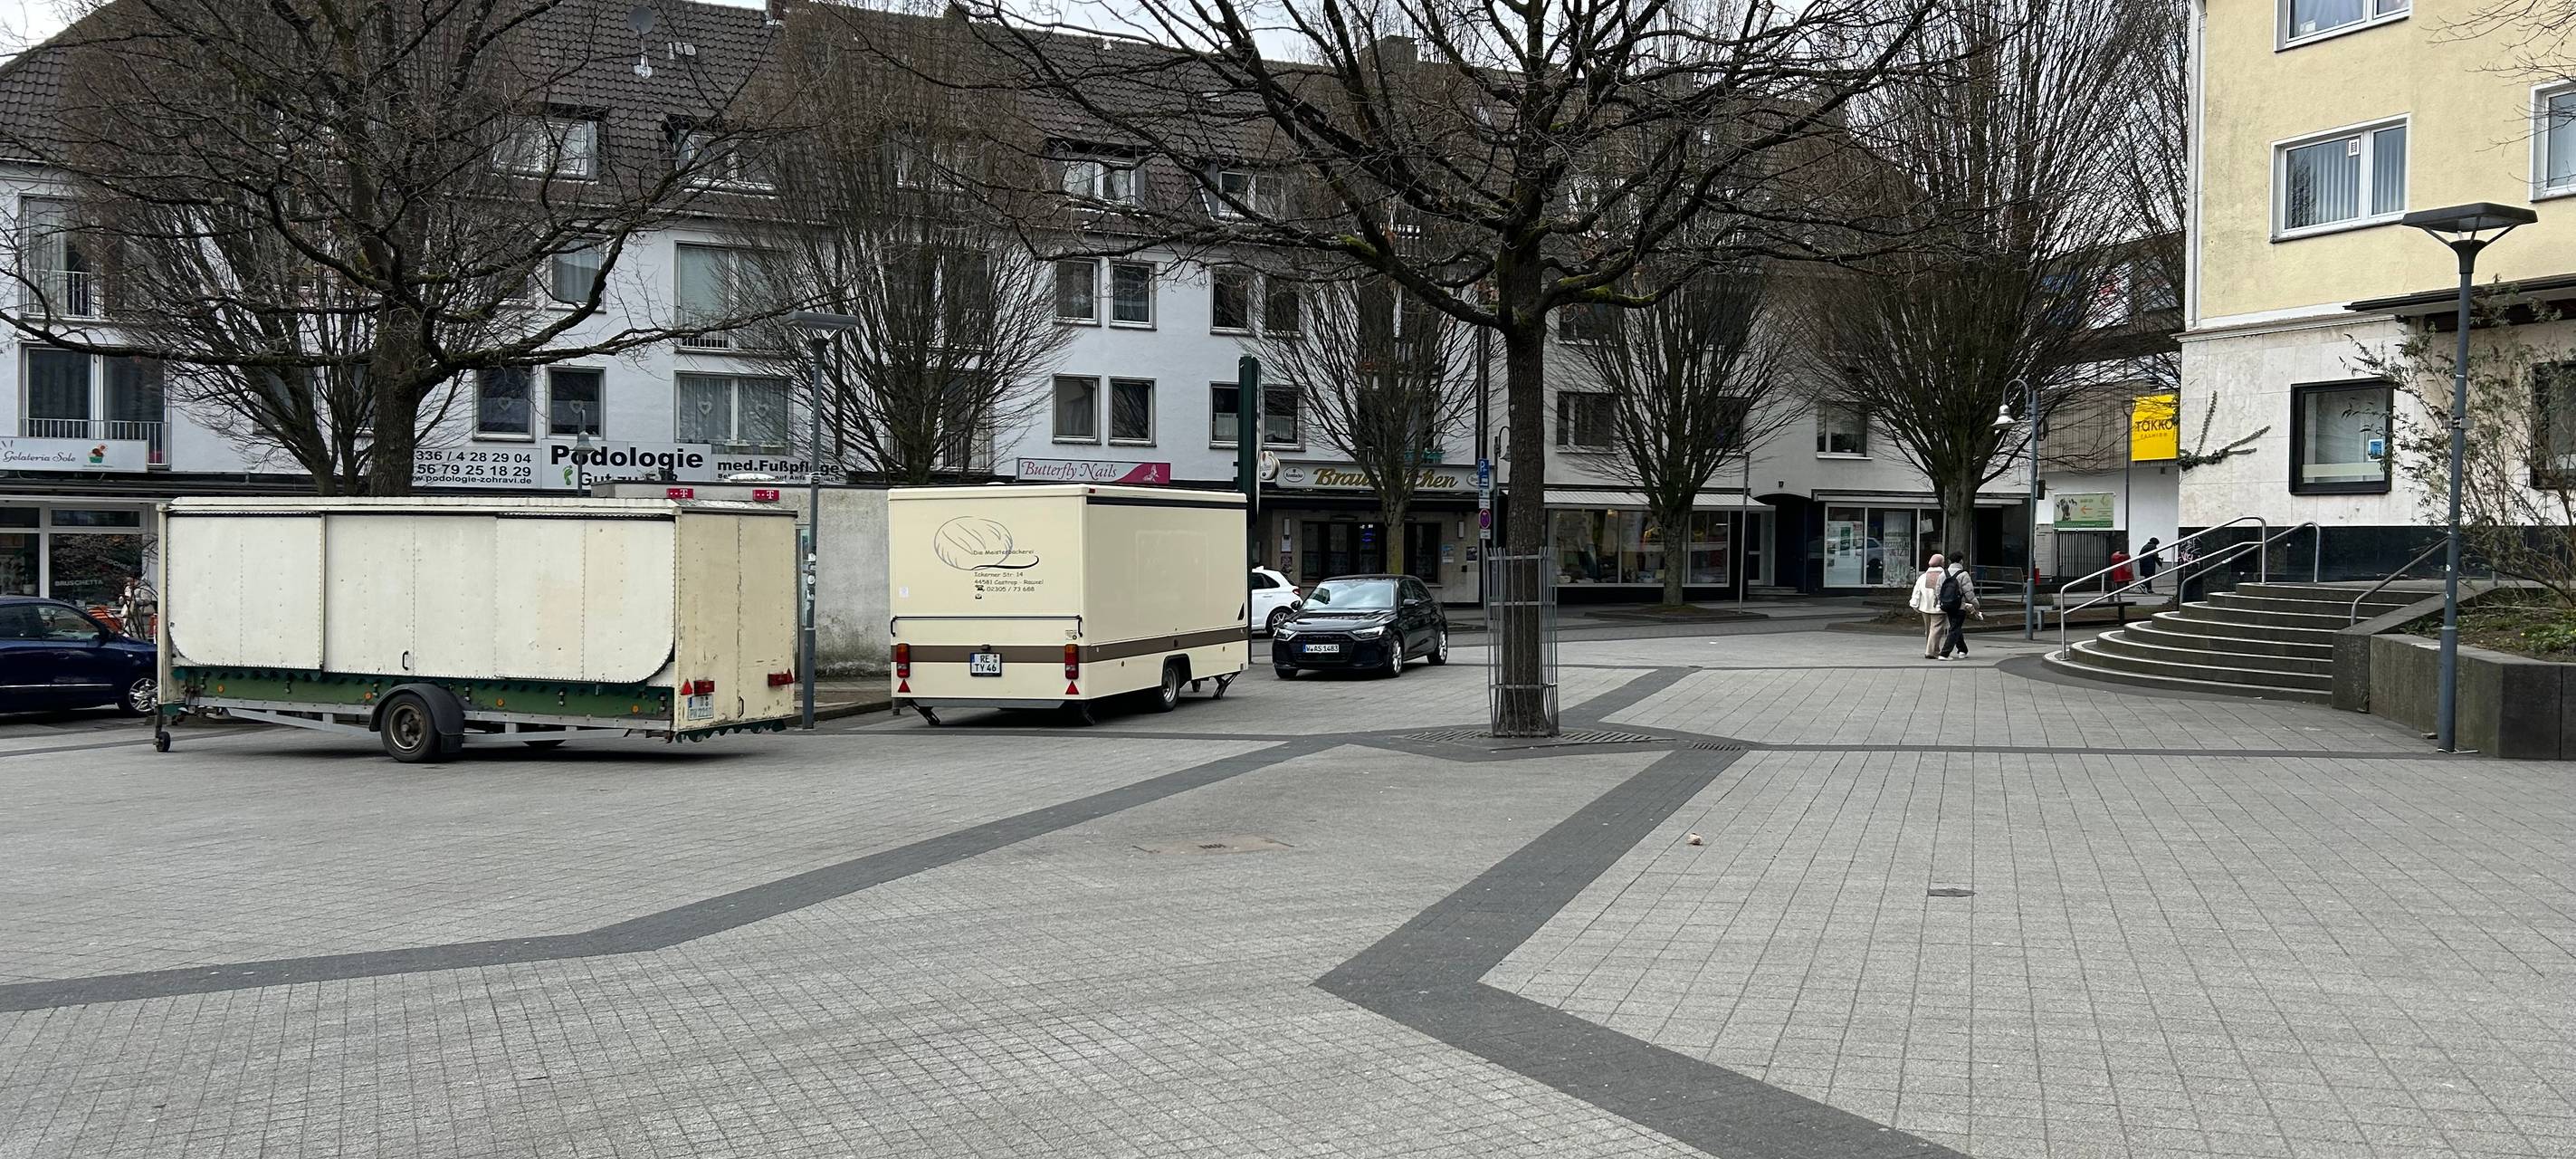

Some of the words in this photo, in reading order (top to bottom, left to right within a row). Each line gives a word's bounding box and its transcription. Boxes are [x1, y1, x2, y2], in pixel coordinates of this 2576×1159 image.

[3, 450, 51, 463] Gelateria
[52, 452, 76, 463] Sole
[456, 452, 465, 461] 4
[470, 452, 487, 462] 28
[491, 453, 510, 463] 29
[514, 454, 531, 463] 04
[551, 445, 703, 471] Podologie
[442, 465, 460, 474] 79
[465, 465, 484, 475] 25
[490, 465, 508, 476] 18
[512, 466, 531, 476] 29
[717, 460, 839, 476] med.Fußpflge
[1021, 460, 1077, 480] Butterfly
[1080, 462, 1117, 481] Nails
[975, 664, 985, 672] TY
[987, 664, 997, 672] 46
